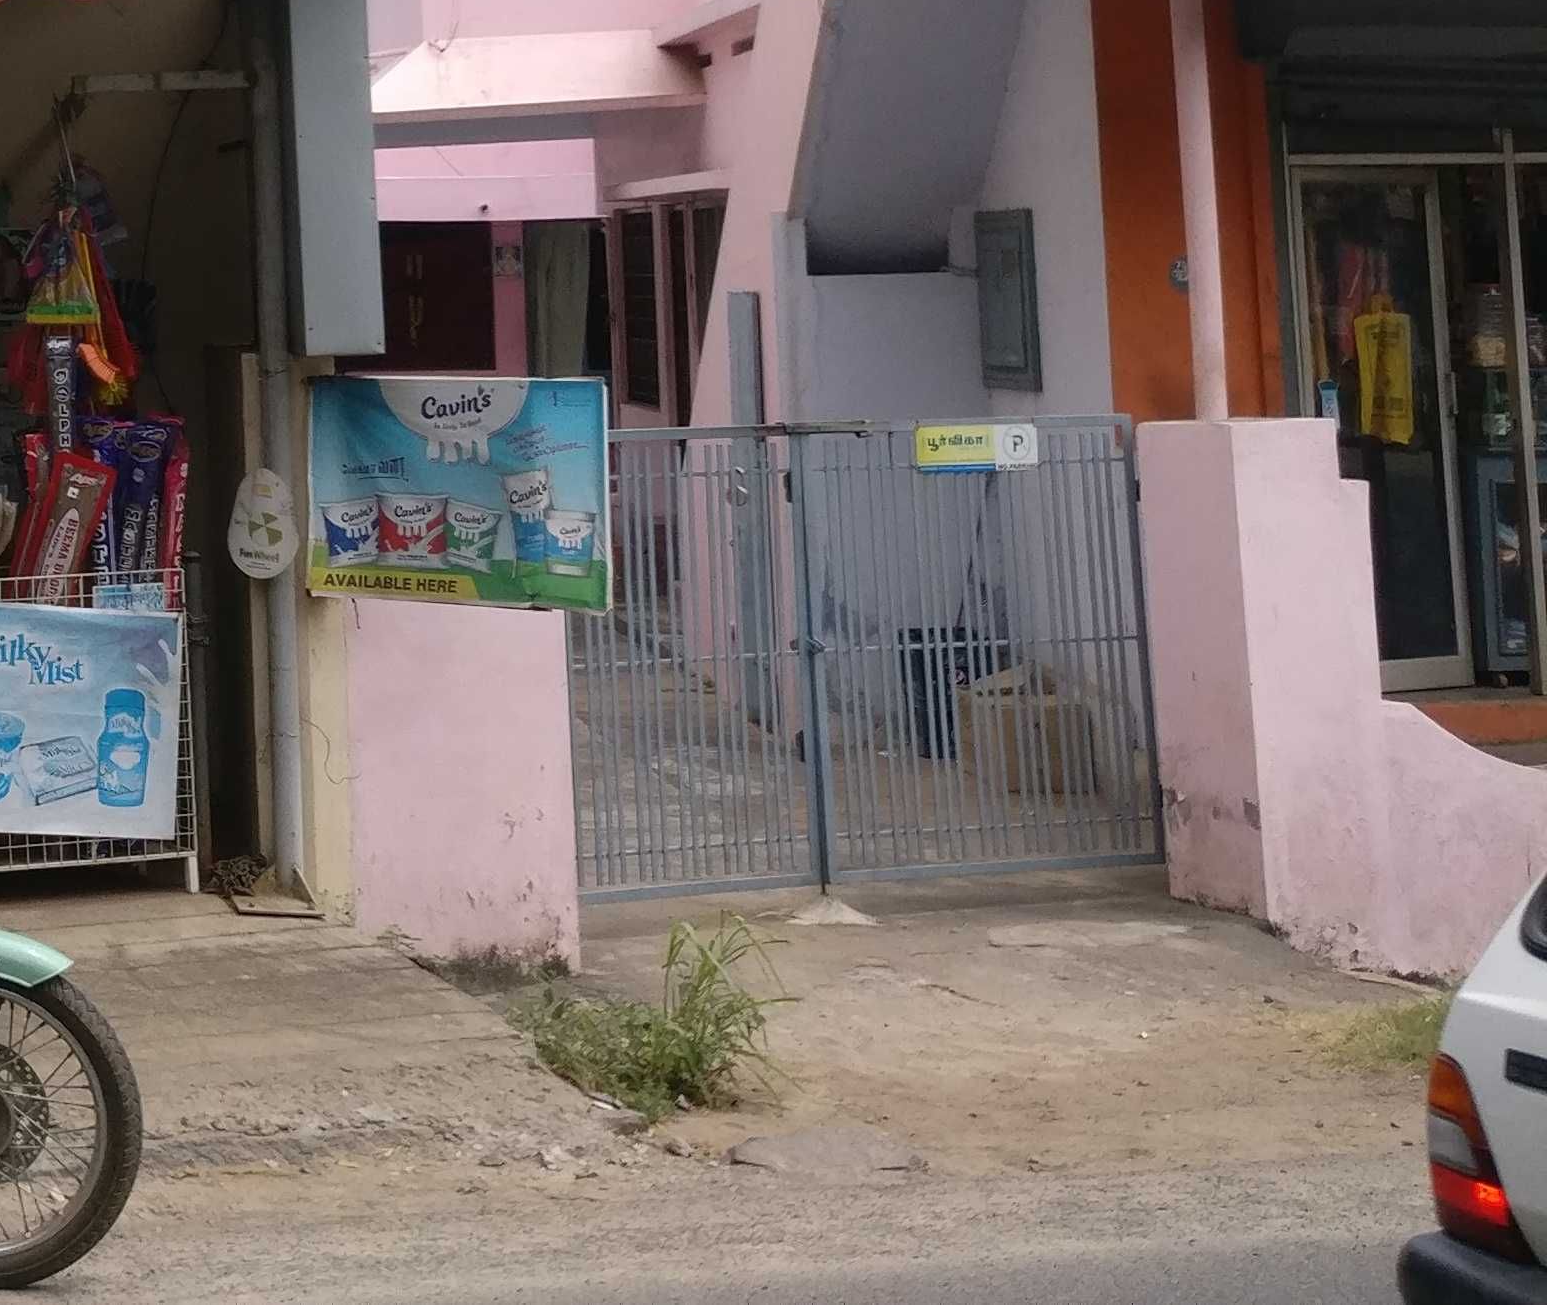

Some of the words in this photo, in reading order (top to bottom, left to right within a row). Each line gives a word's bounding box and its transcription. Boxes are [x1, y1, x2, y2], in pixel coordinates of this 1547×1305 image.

[421, 385, 491, 419] Cavin's
[509, 481, 547, 504] Cavin's
[394, 501, 433, 518] Cavin's
[323, 572, 414, 591] AVAILABLE
[416, 578, 457, 593] HERE
[29, 656, 84, 686] Mist
